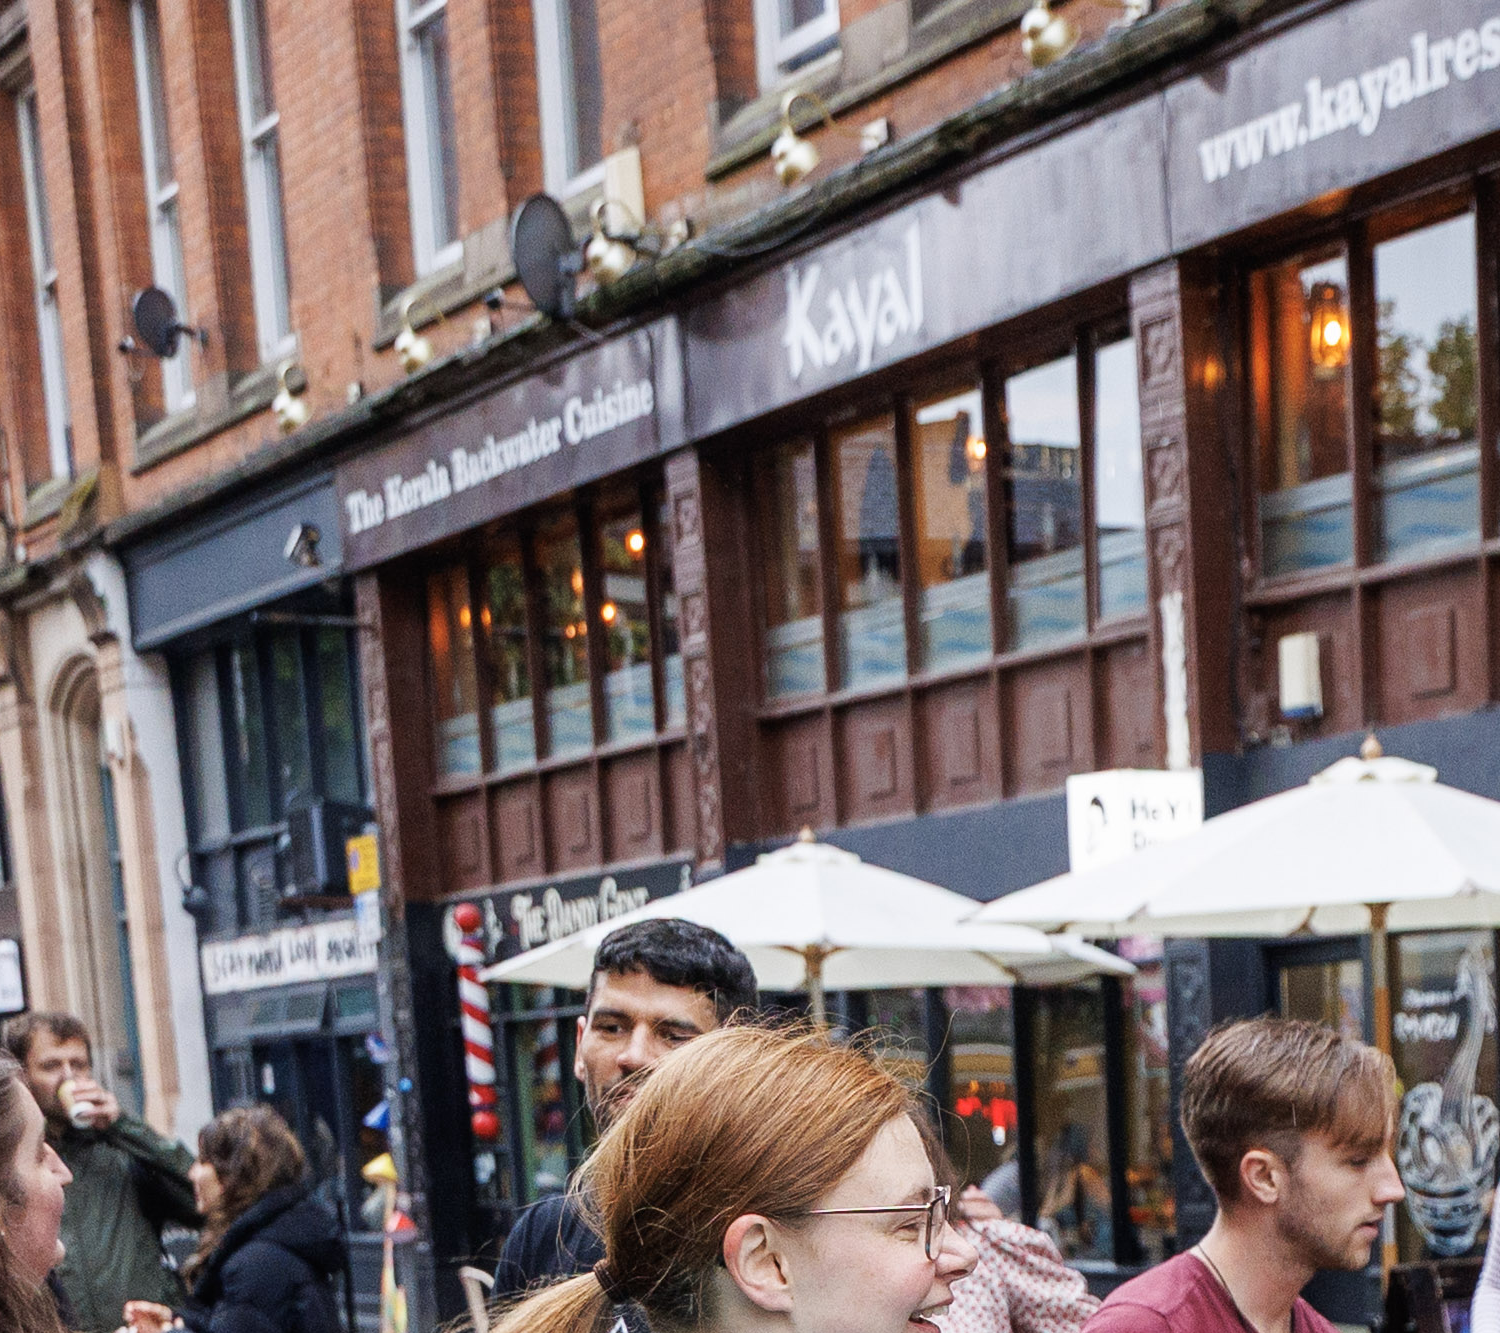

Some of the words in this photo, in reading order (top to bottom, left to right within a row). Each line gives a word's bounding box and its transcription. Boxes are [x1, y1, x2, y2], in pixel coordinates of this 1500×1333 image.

[783, 219, 924, 381] Kayal
[346, 488, 385, 535] The
[384, 459, 452, 520] Kerala
[451, 417, 563, 494] Backwater
[563, 378, 655, 446] Cuisine
